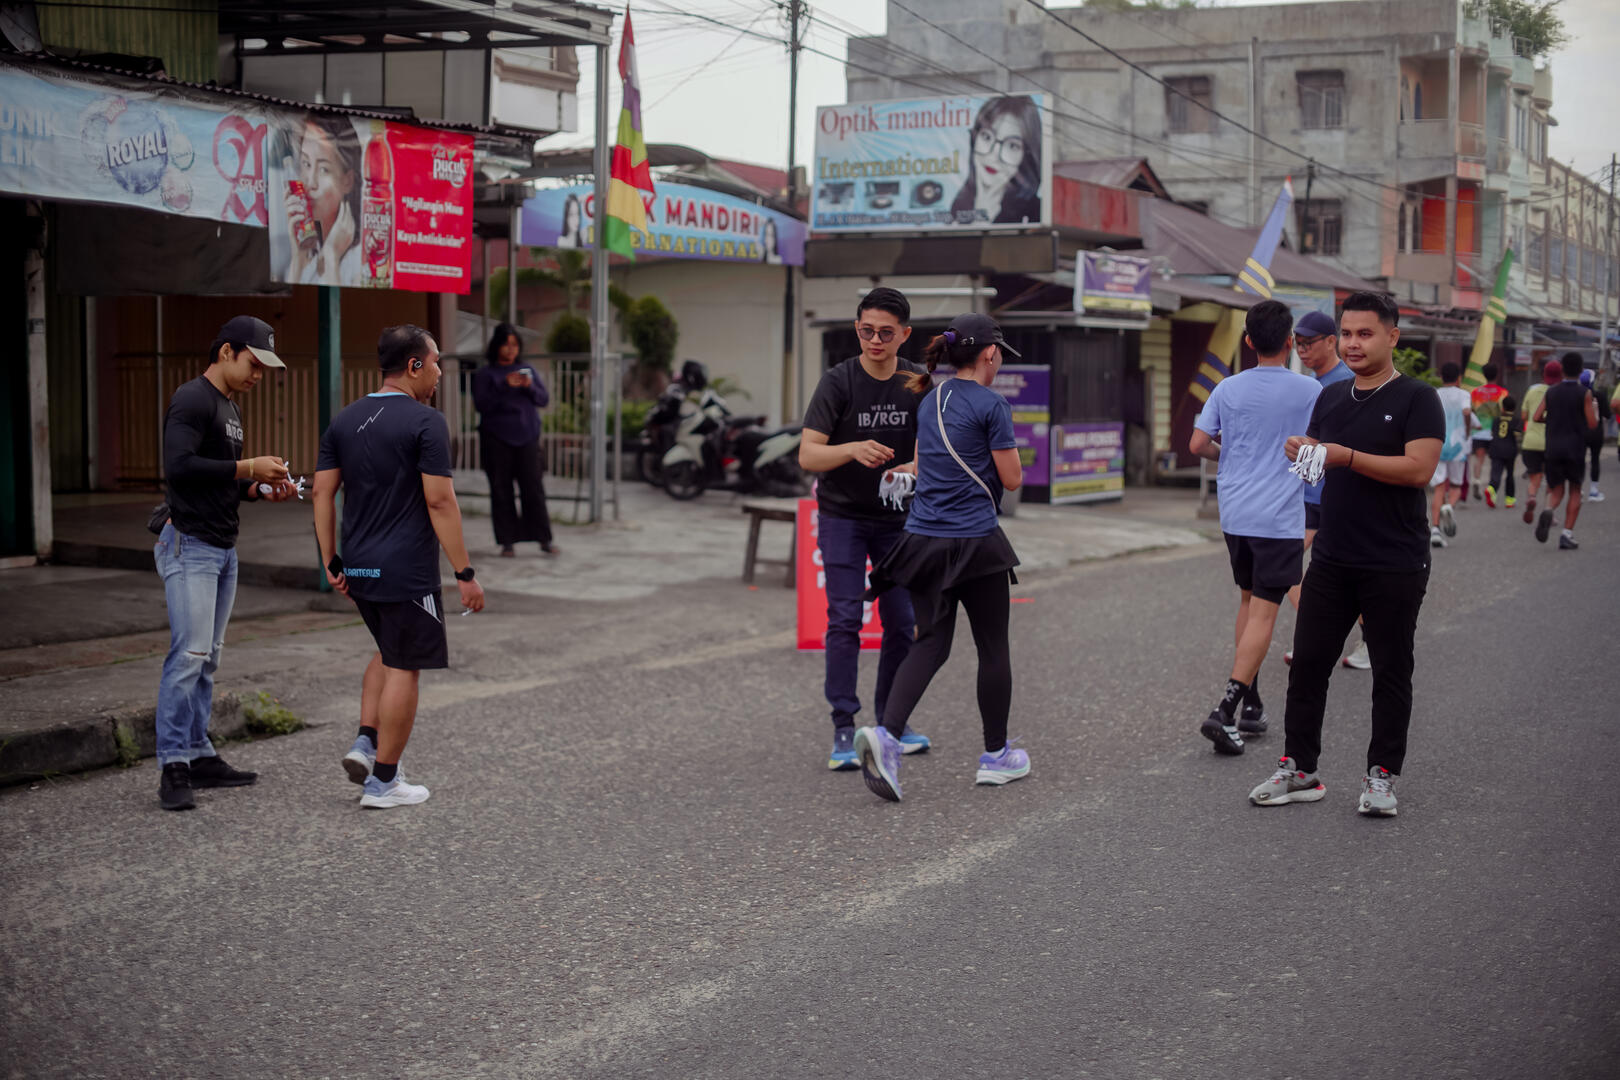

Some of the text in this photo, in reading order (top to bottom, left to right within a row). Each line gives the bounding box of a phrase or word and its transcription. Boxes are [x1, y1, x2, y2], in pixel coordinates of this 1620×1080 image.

[821, 101, 972, 139] Optik mandiri
[106, 130, 168, 168] ROYAL
[819, 151, 960, 180] International
[664, 196, 760, 236] MANDIRI
[588, 225, 759, 259] IERNATIONAL
[858, 411, 909, 428] IB/RGT
